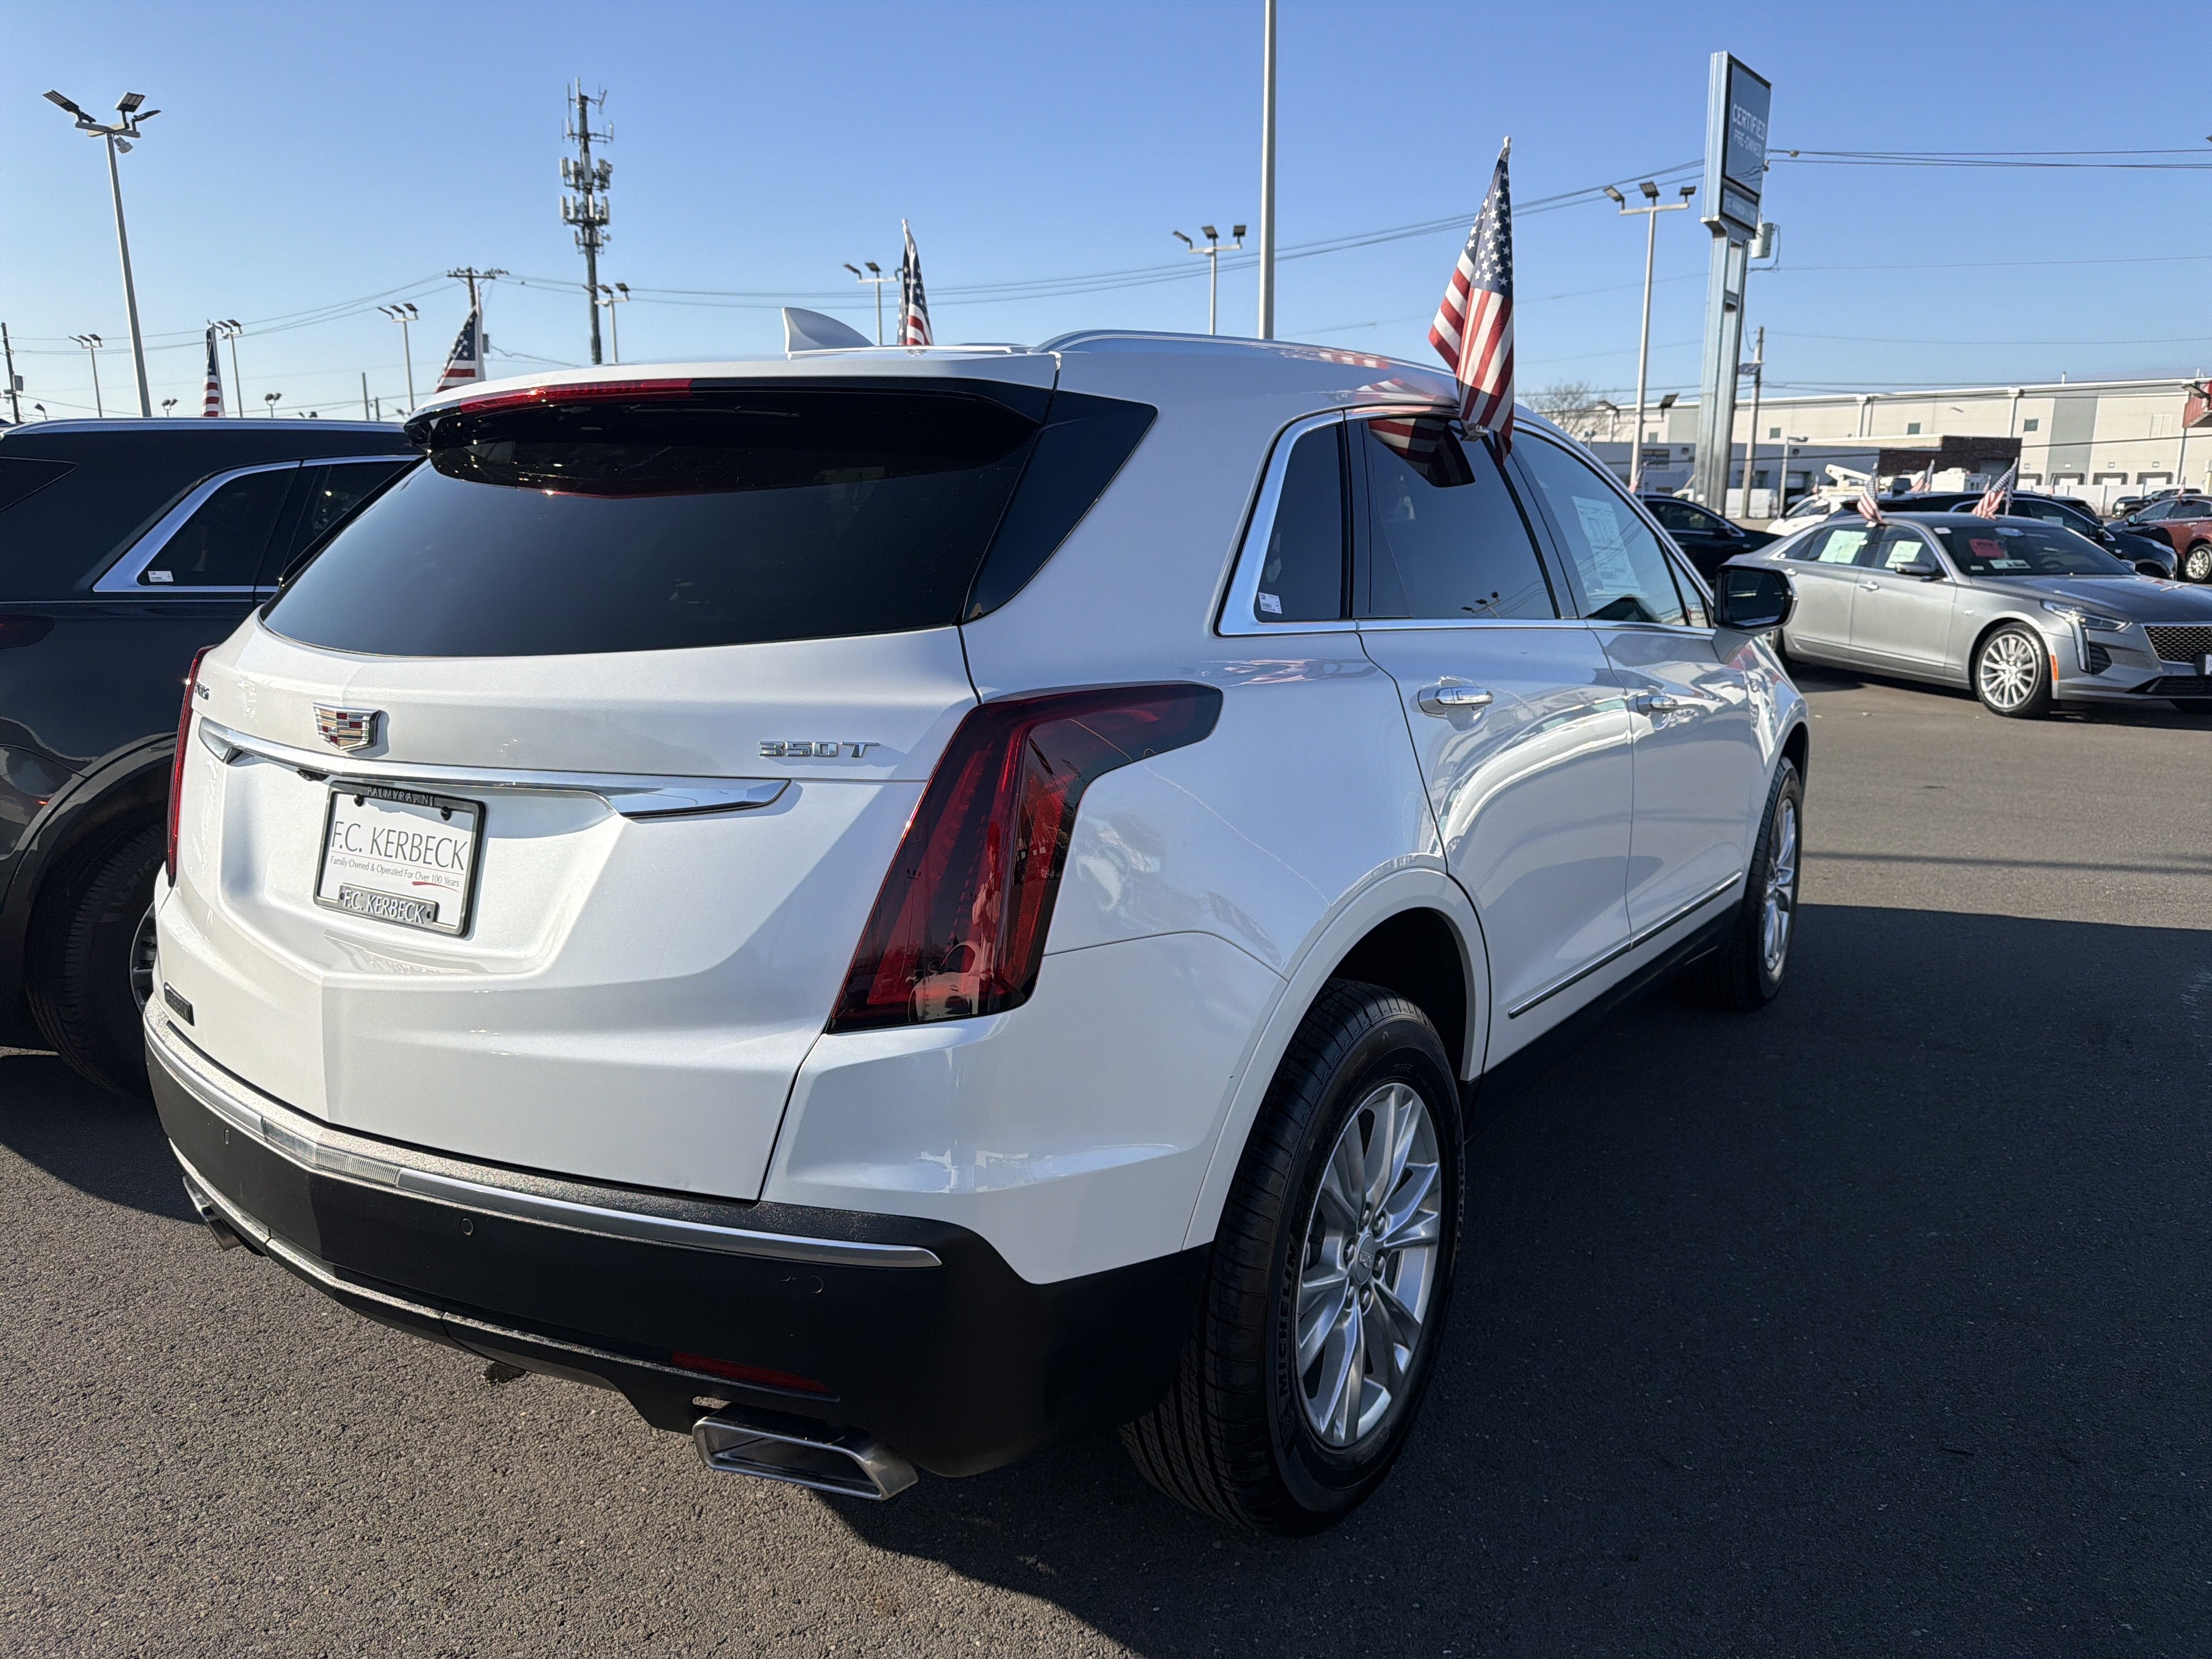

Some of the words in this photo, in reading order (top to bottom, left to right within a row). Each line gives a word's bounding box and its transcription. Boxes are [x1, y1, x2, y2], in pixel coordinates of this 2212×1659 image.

[1733, 104, 1765, 140] CERTIFIED
[758, 741, 880, 758] 350T
[368, 787, 416, 804] PALMYRA,
[331, 821, 363, 853] F.C.
[370, 826, 468, 871] KERBECK
[330, 856, 348, 868] Family
[348, 859, 369, 871] Owned
[376, 864, 403, 877] Operated
[404, 870, 414, 878] For
[415, 871, 430, 881] Over
[431, 874, 442, 884] 100
[444, 877, 460, 887] Years
[343, 889, 363, 911] F.C.
[366, 894, 426, 924] KERBECK
[1278, 1241, 1297, 1397] MICHELIN
